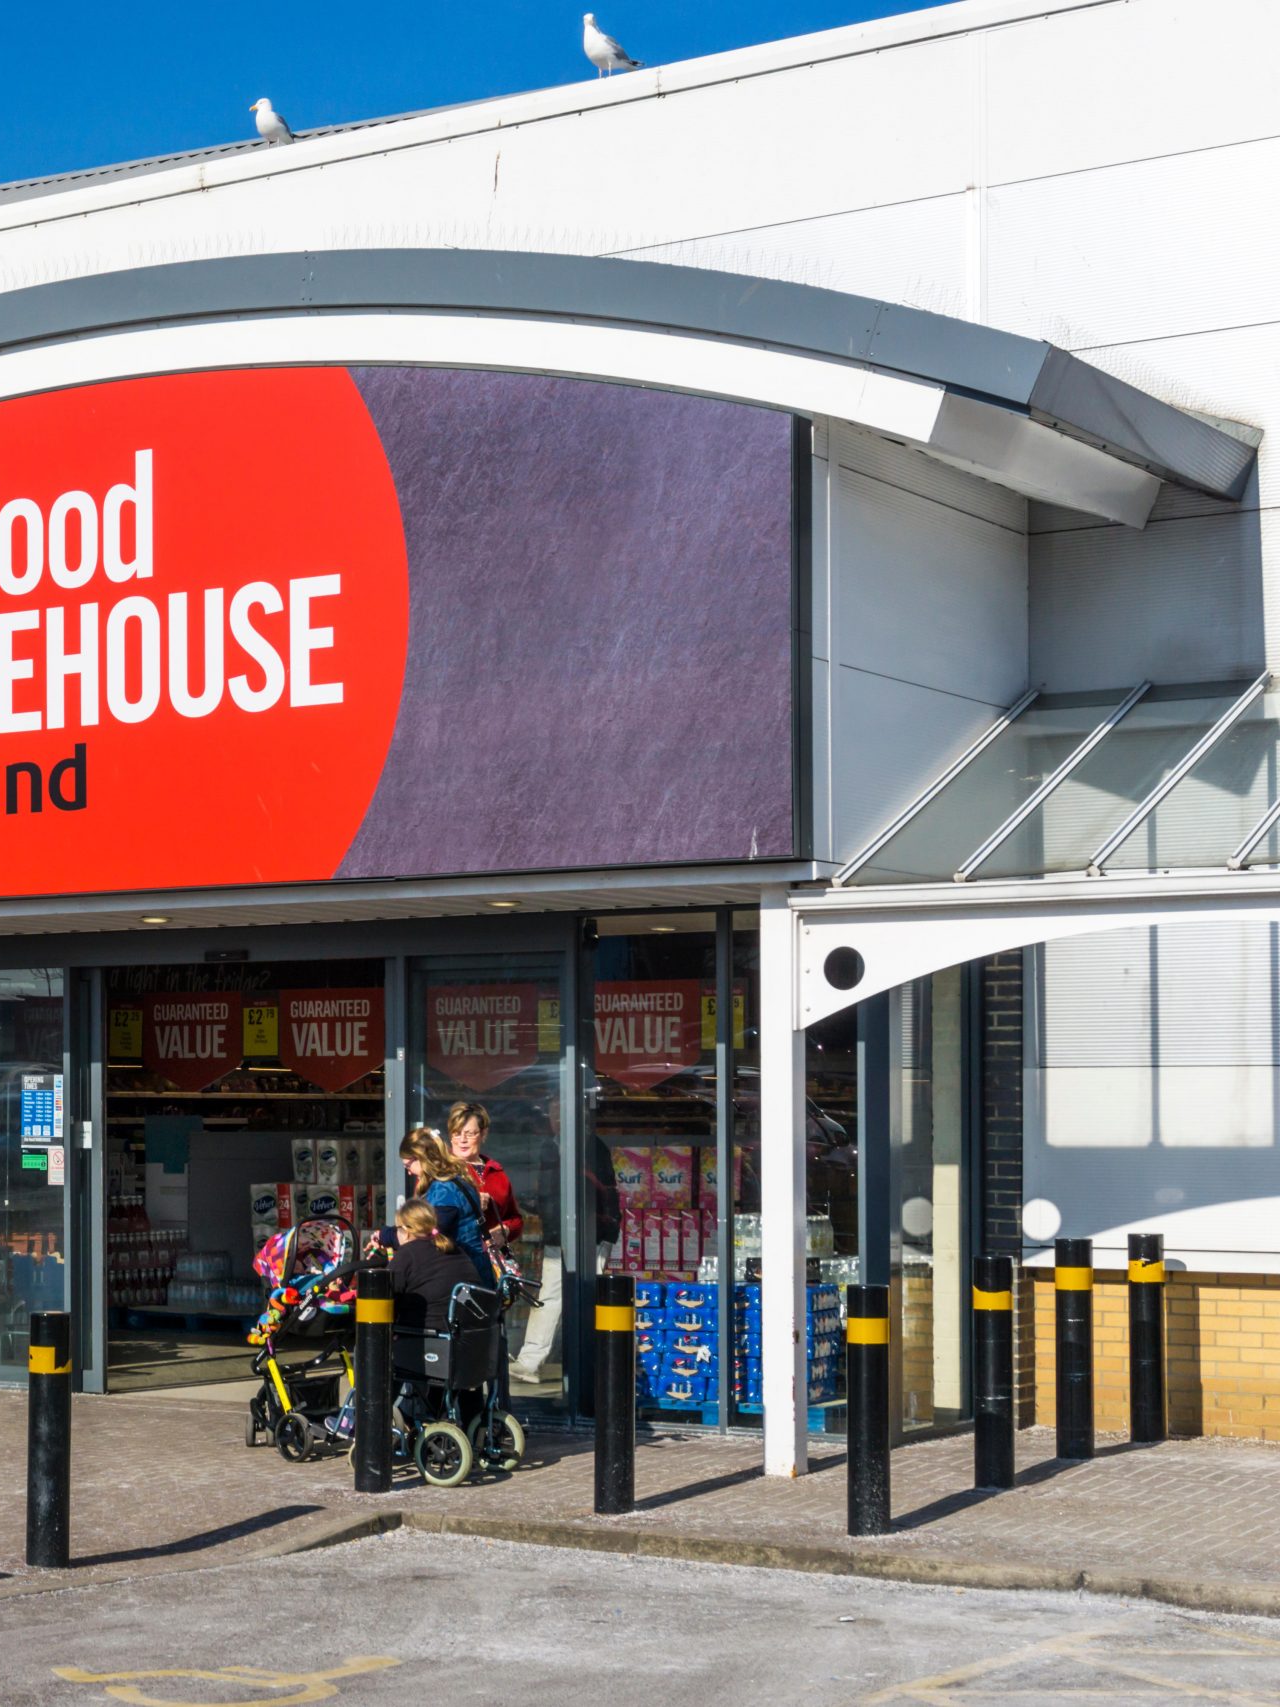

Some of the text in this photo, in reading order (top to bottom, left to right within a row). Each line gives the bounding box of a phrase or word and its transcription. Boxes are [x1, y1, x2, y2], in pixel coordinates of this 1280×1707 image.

[153, 1002, 229, 1021] GUARANTEED
[290, 999, 370, 1018] GUARANTEED
[435, 996, 521, 1016] GUARANTEED
[594, 992, 684, 1013] GUARANTEED
[154, 1024, 227, 1059] VALUE
[291, 1021, 369, 1057] VALUE
[436, 1019, 520, 1056] VALUE
[593, 1016, 682, 1054] VALUE
[617, 1172, 642, 1184] Surf
[658, 1172, 683, 1184] Surf
[279, 1199, 290, 1209] 24
[341, 1200, 353, 1211] 24
